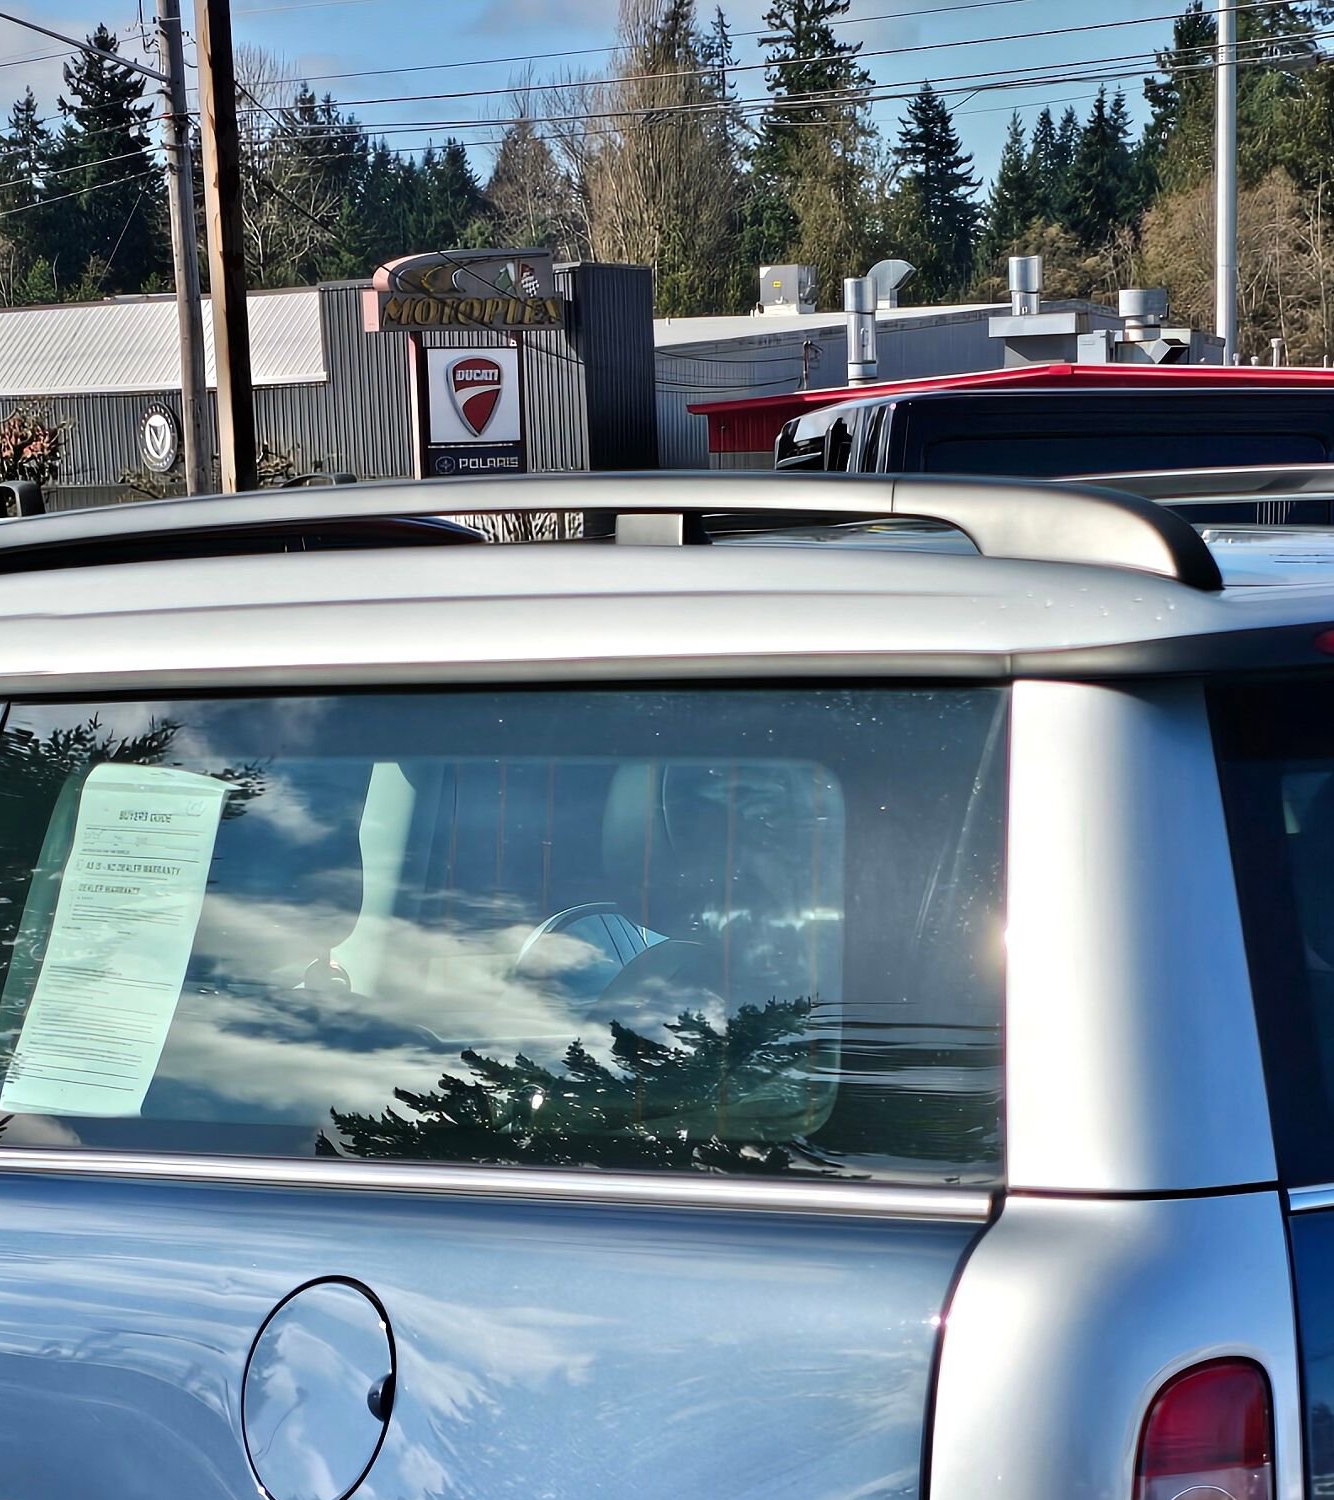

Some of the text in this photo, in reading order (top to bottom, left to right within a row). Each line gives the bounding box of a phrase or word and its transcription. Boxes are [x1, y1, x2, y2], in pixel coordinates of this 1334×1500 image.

[381, 296, 562, 328] MOTOPLEX
[455, 368, 499, 381] DUCATI
[459, 456, 519, 470] POLARIS
